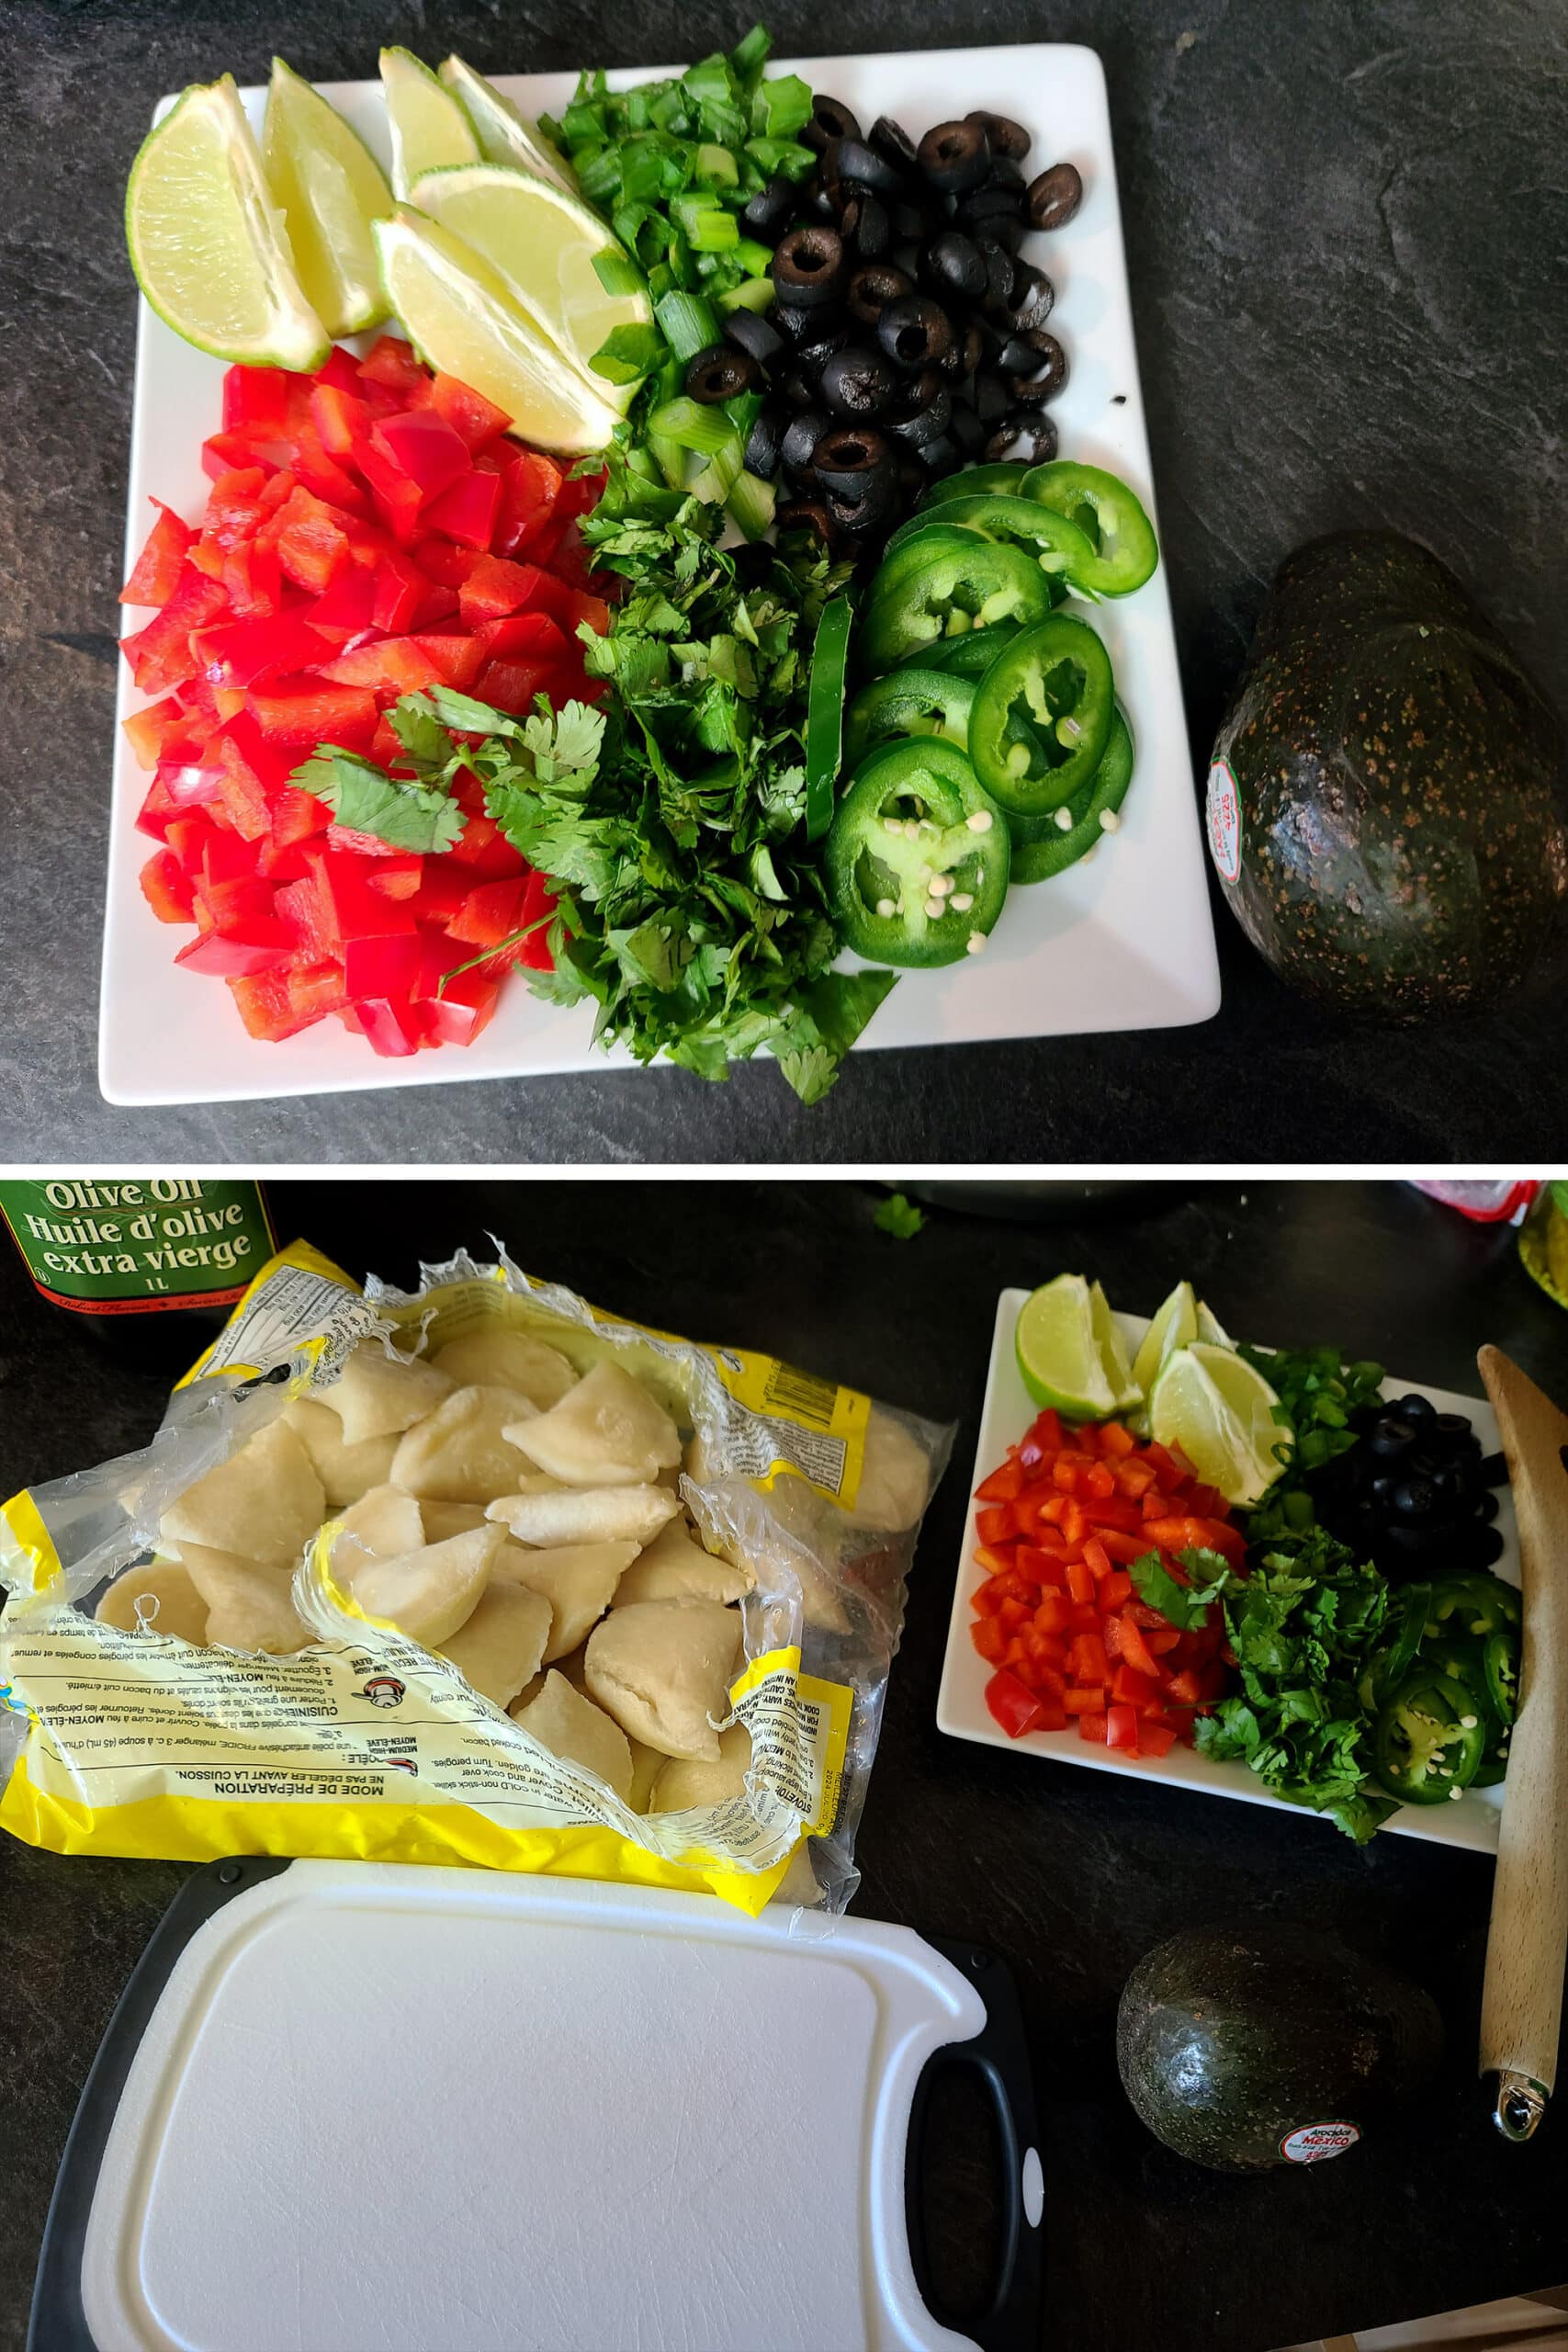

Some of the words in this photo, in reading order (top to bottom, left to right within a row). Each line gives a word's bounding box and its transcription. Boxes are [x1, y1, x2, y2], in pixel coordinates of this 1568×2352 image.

[45, 1180, 144, 1211] Olive
[150, 1180, 205, 1204] Oil
[23, 1212, 124, 1246] Huile
[130, 1204, 244, 1241] d'olive
[43, 1250, 140, 1275] extra
[142, 1234, 252, 1270] vierge
[60, 1628, 86, 1638] temps
[54, 1650, 96, 1661] congelés
[98, 1651, 134, 1662] pérogies
[177, 1649, 195, 1661] cuit
[183, 1659, 235, 1670] délicatemen
[280, 1666, 321, 1677] Égoutter.
[322, 1667, 332, 1675] 3.
[265, 1674, 280, 1683] feu
[281, 1675, 288, 1683] à
[783, 1675, 796, 1688] AN
[104, 1684, 121, 1694] cuit
[124, 1685, 152, 1695] bacon
[153, 1687, 165, 1696] du
[253, 1684, 273, 1694] pour
[274, 1686, 325, 1696] doucement
[280, 1696, 297, 1704] une
[299, 1696, 327, 1704] Porter
[41, 1702, 84, 1714] pérogies
[85, 1704, 98, 1713] les
[101, 1704, 145, 1714] Retourner
[147, 1707, 176, 1717] dorés.
[801, 1702, 821, 1717] COOK
[179, 1709, 205, 1718] soient
[107, 1715, 121, 1724] feu
[123, 1715, 130, 1724] à
[131, 1715, 154, 1725] cuire
[166, 1717, 200, 1728] Couvrir
[806, 1714, 819, 1727] FOR
[103, 1738, 117, 1747] (45
[118, 1736, 146, 1747] soupe
[147, 1737, 154, 1747] à
[166, 1737, 174, 1747] 3
[175, 1737, 217, 1747] mélanger
[460, 1737, 491, 1749] bacon.
[431, 1756, 472, 1770] perogies.
[473, 1758, 493, 1770] Turn
[494, 1758, 532, 1773] golden.
[175, 1770, 231, 1781] CUISSON.
[235, 1771, 249, 1780] LA
[252, 1771, 288, 1780] AVANT
[291, 1773, 343, 1783] DÉGELER
[345, 1775, 367, 1783] PAS
[368, 1775, 384, 1783] NE
[461, 1769, 482, 1779] over
[483, 1769, 506, 1781] cook
[507, 1772, 526, 1782] and
[457, 1780, 499, 1791] non-stick
[527, 1776, 563, 1795] Cover
[824, 1770, 833, 1791] 2024
[213, 1783, 314, 1797] PRÉPARATION
[318, 1784, 338, 1794] DE
[341, 1785, 384, 1796] MODE
